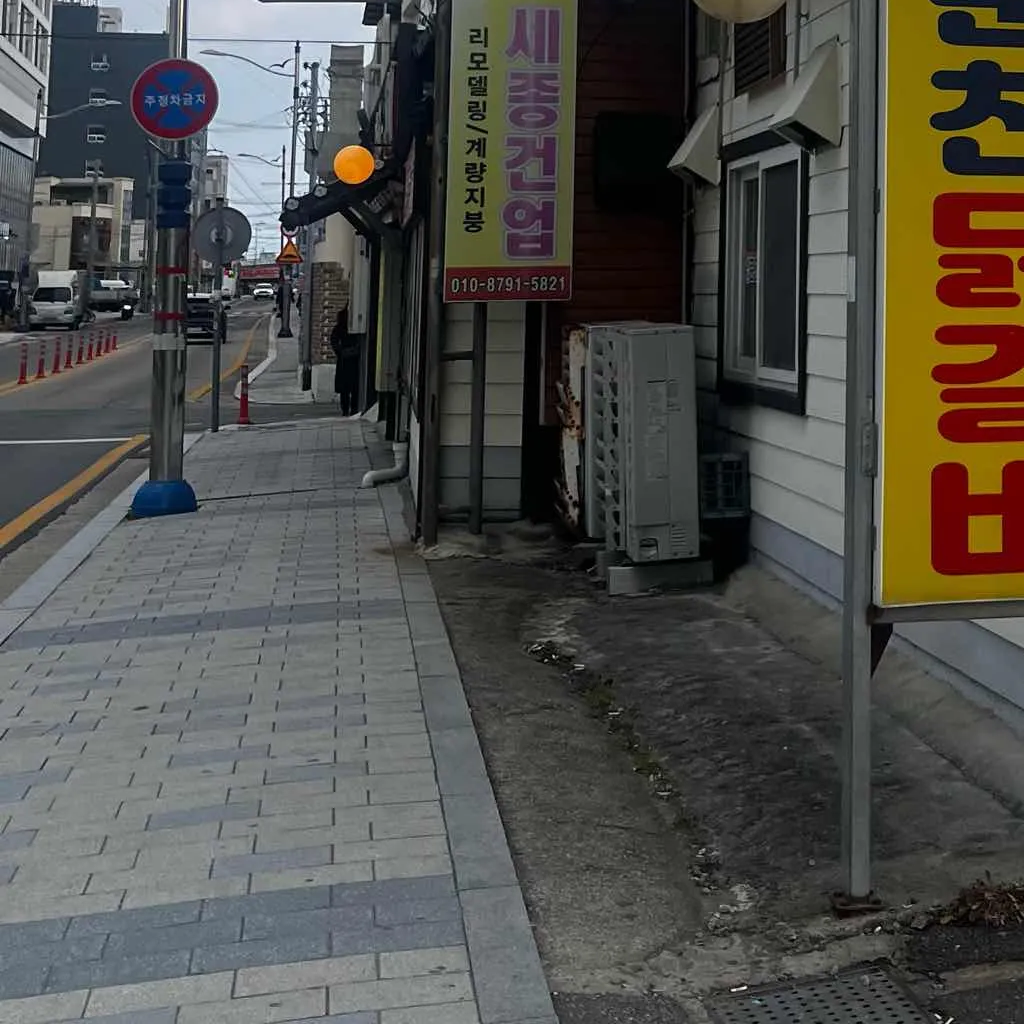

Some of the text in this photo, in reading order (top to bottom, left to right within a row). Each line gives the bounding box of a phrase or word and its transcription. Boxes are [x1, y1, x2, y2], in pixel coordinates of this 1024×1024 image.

[144, 92, 206, 109] 주정차금지
[501, 6, 562, 259] 세종건업
[451, 276, 566, 293] 010-8791-5821
